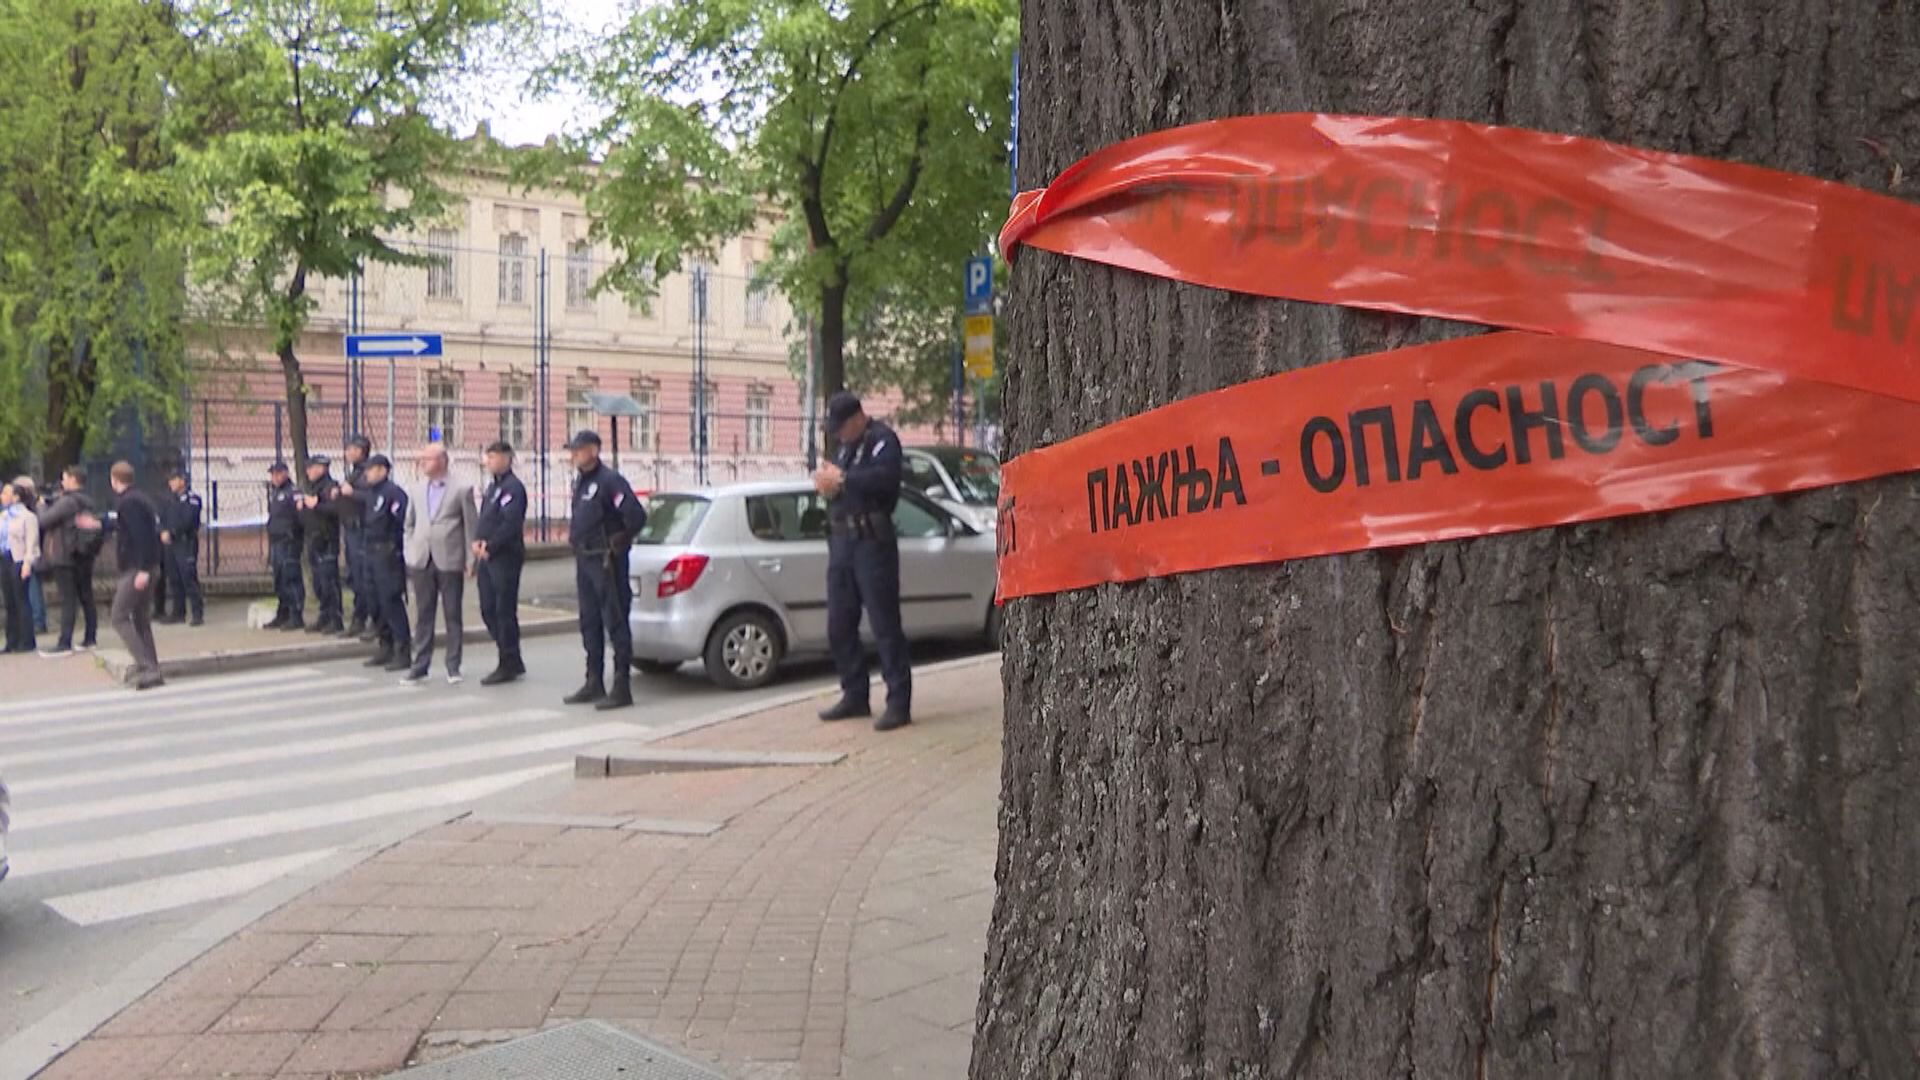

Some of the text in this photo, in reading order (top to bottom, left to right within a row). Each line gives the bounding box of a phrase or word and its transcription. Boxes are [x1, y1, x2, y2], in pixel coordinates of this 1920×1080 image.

[970, 262, 987, 295] P
[1087, 436, 1247, 533] ПАЖЊА
[1300, 361, 1724, 493] ОПАСНОСТ
